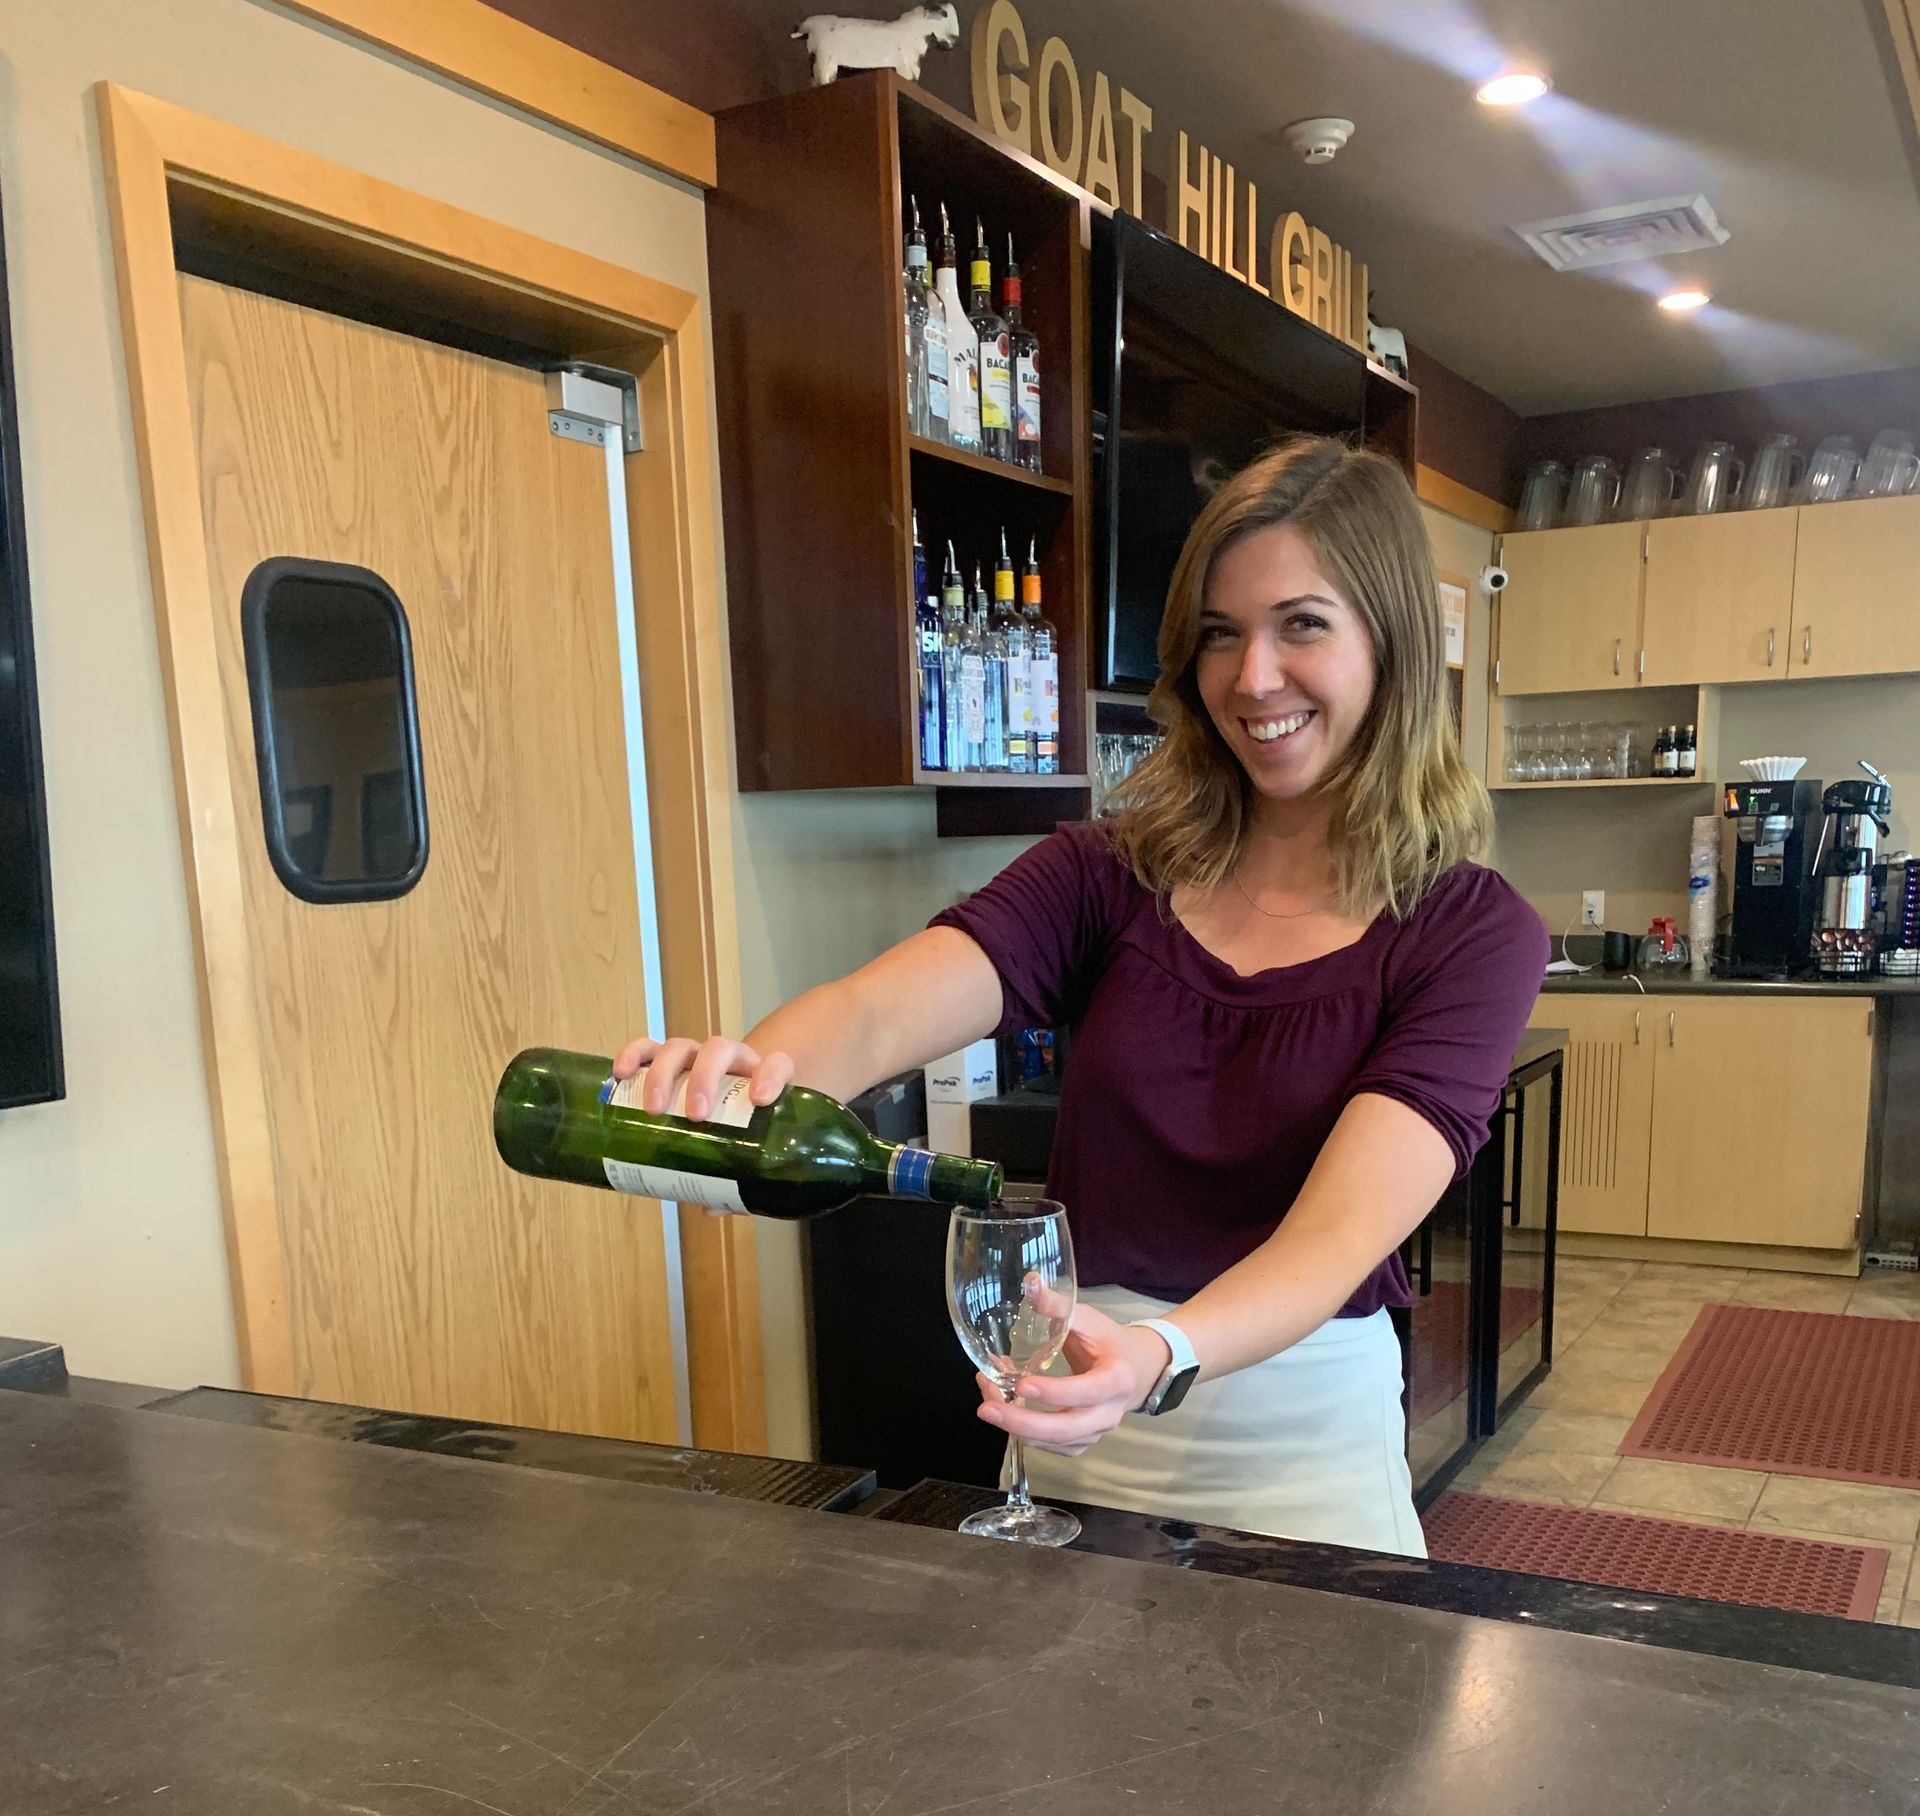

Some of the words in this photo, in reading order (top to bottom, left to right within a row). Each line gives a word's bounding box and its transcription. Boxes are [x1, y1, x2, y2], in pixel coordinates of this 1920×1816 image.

[971, 0, 1152, 221] GOAT
[1177, 130, 1270, 297] HILL
[1749, 786, 1772, 795] BUNN
